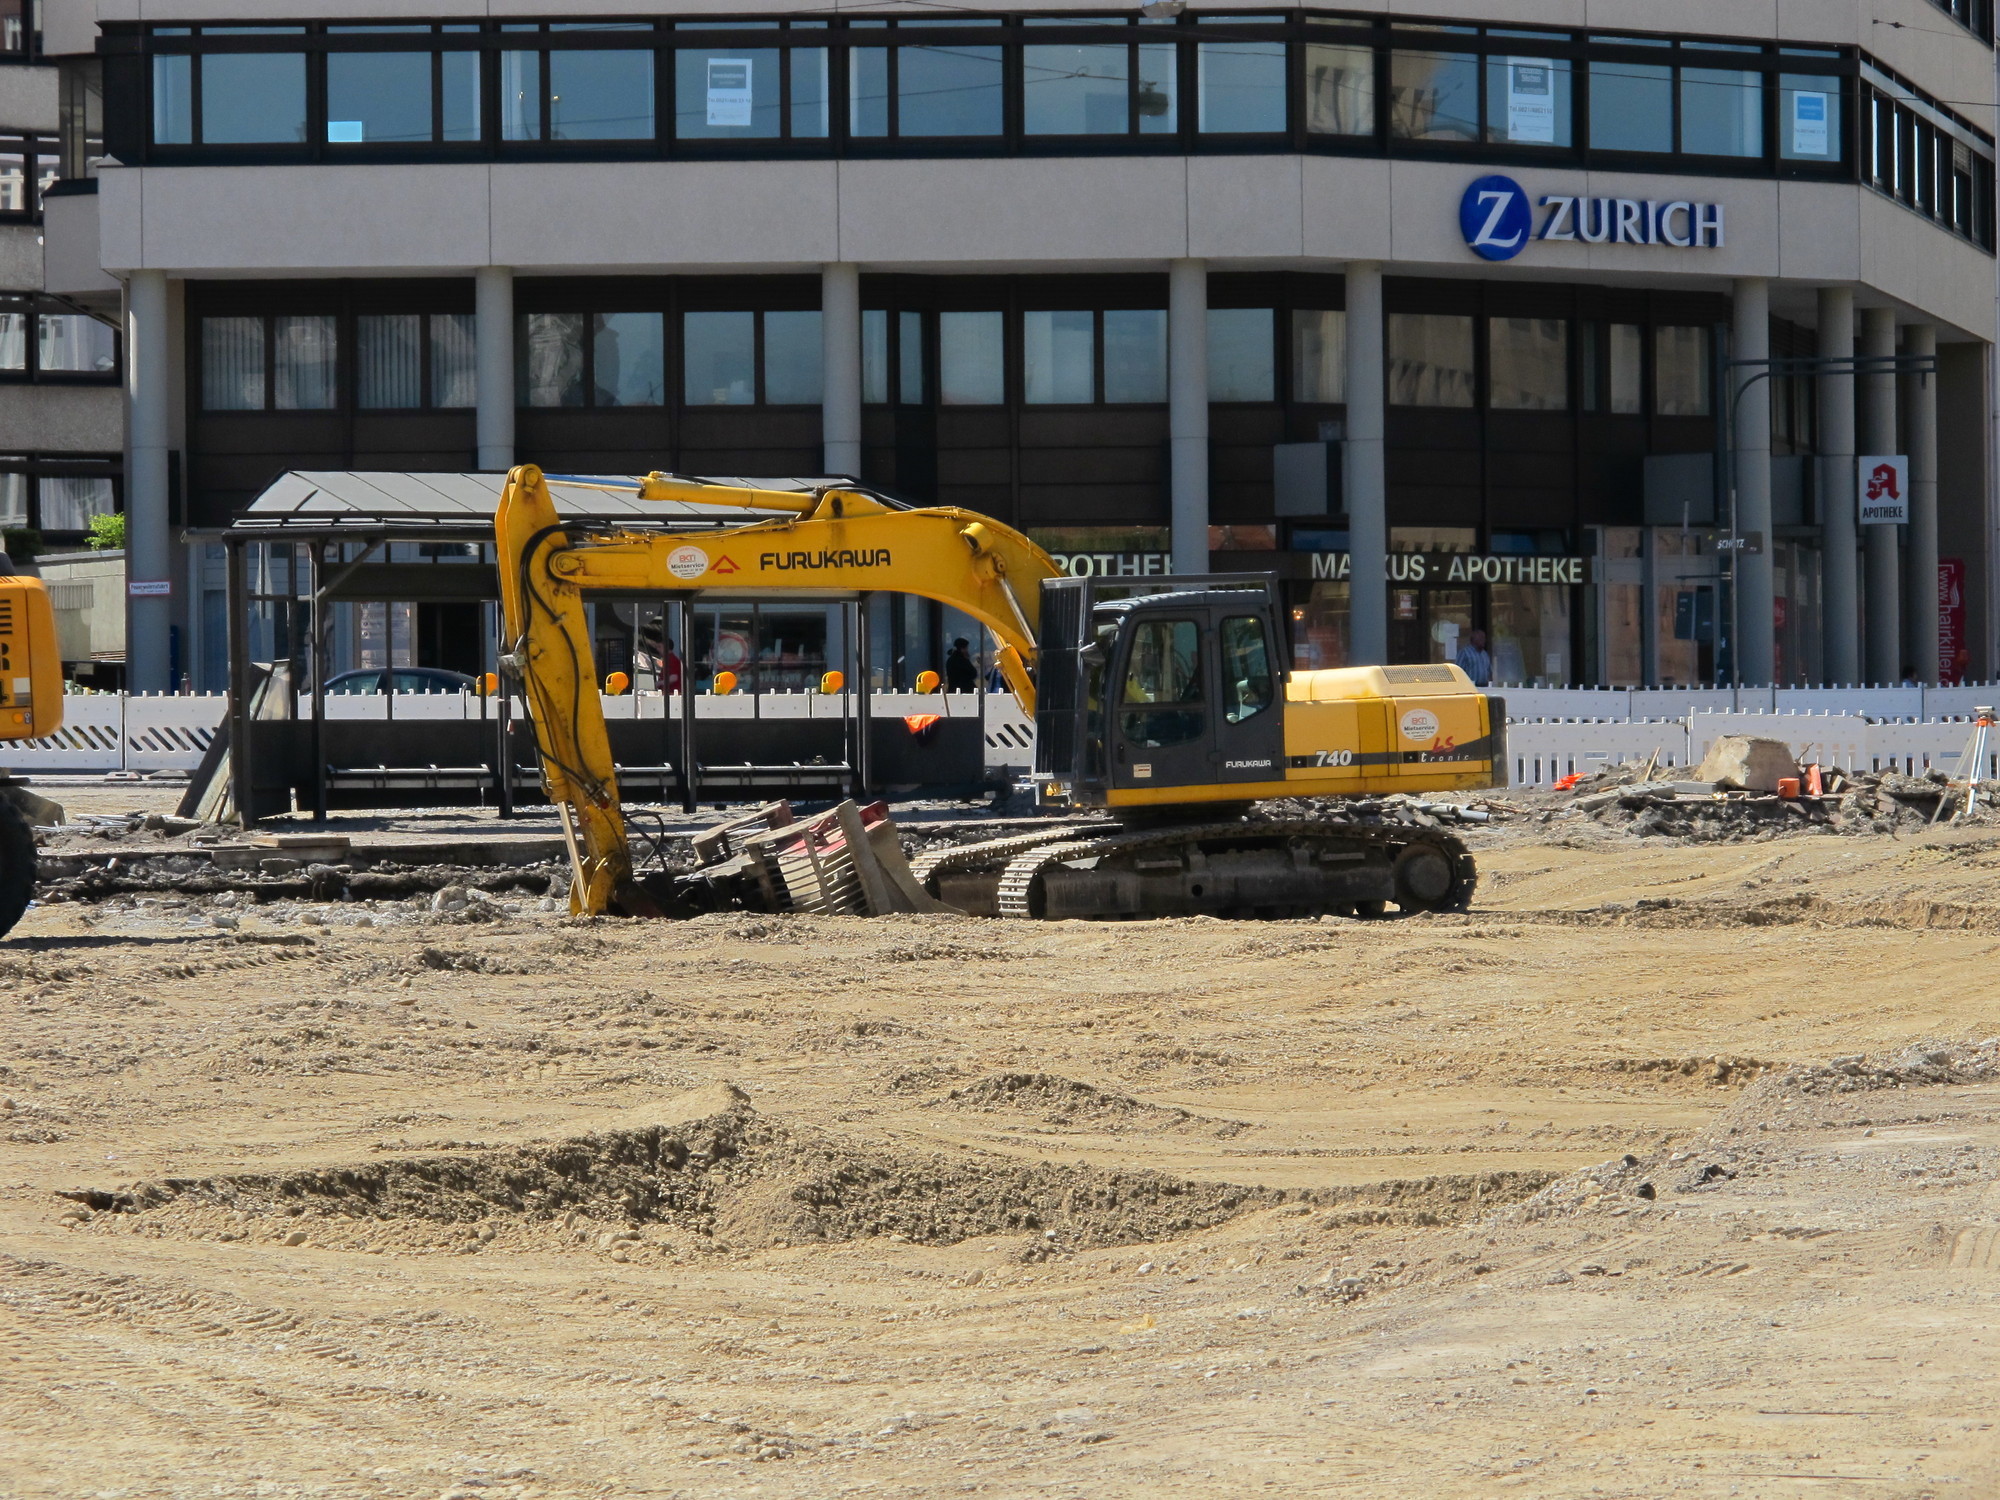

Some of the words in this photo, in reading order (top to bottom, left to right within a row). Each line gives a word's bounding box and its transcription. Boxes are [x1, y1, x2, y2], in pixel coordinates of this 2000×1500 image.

[1473, 189, 1523, 249] Z
[1540, 195, 1726, 248] ZURICH
[1862, 506, 1903, 518] APOTHEKE
[1717, 538, 1745, 550] SCHTZ
[760, 549, 891, 571] FURUKAWA
[1311, 553, 1425, 581] MAUS
[1447, 555, 1583, 584] APOTHEKE
[1225, 759, 1272, 769] FURUKAWA
[1315, 749, 1353, 767] 740
[1421, 752, 1470, 763] tronic
